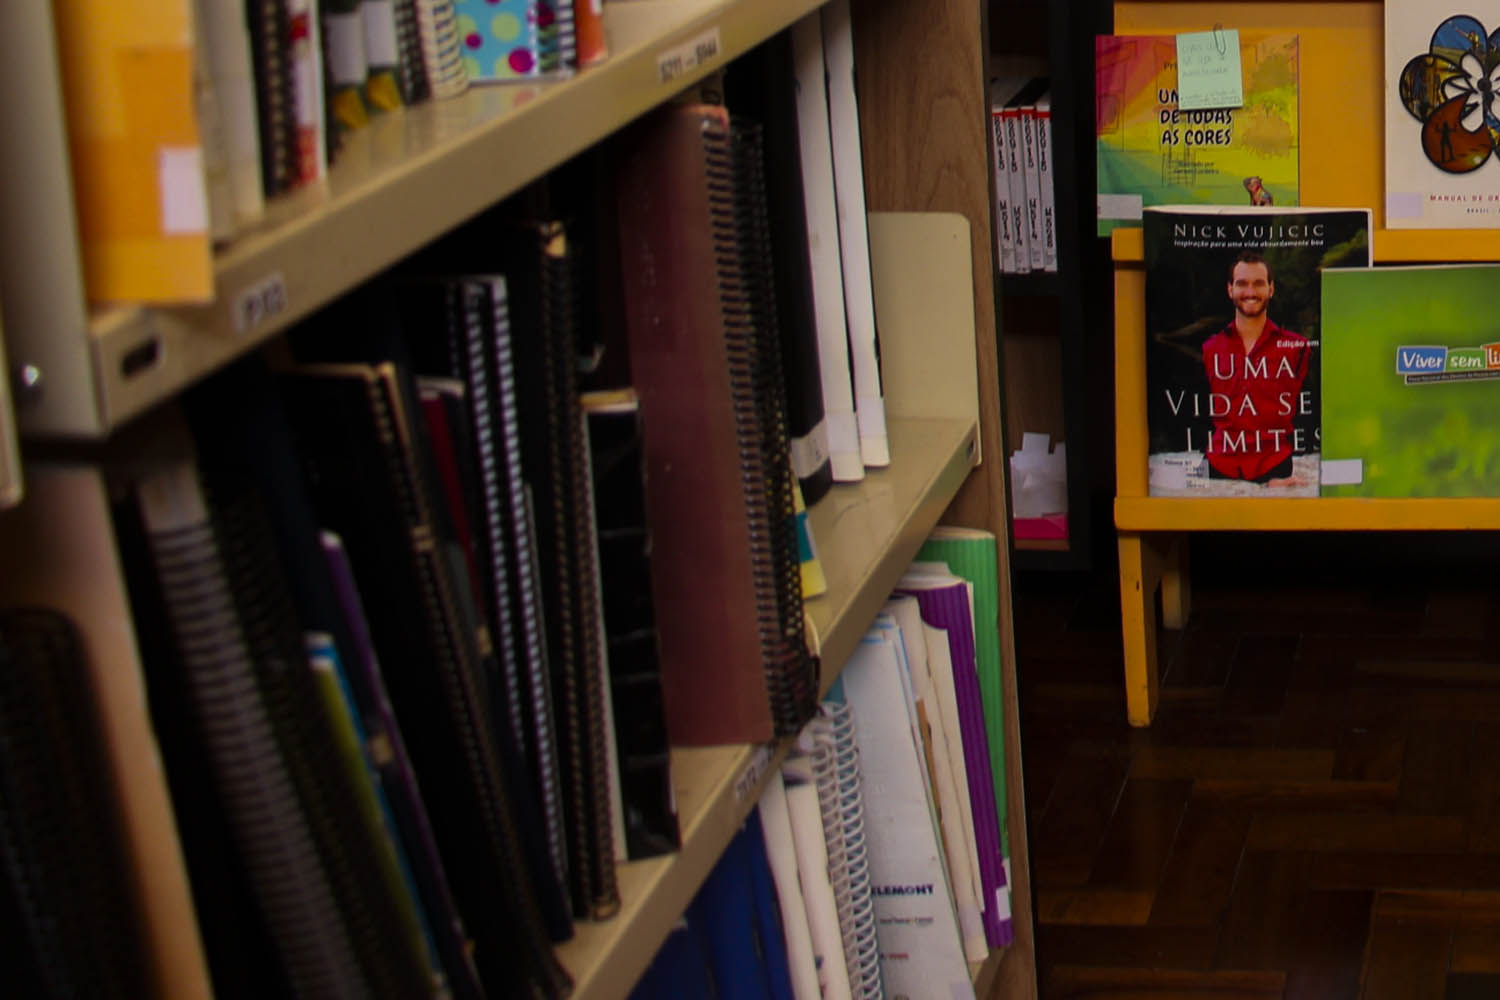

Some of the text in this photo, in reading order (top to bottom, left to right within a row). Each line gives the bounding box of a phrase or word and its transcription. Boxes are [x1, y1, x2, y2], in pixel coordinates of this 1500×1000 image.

[1160, 108, 1232, 125] DE TODAS
[1162, 128, 1232, 146] AS CORES
[1430, 194, 1467, 202] MANUAL
[1174, 223, 1325, 239] NICK VUJICIC
[1174, 240, 1209, 249] Inspiração
[1276, 338, 1305, 350] Edição
[1213, 353, 1296, 380] UMA
[1402, 351, 1444, 369] Viver
[1449, 355, 1483, 368] sem
[1165, 389, 1258, 418] VIDA
